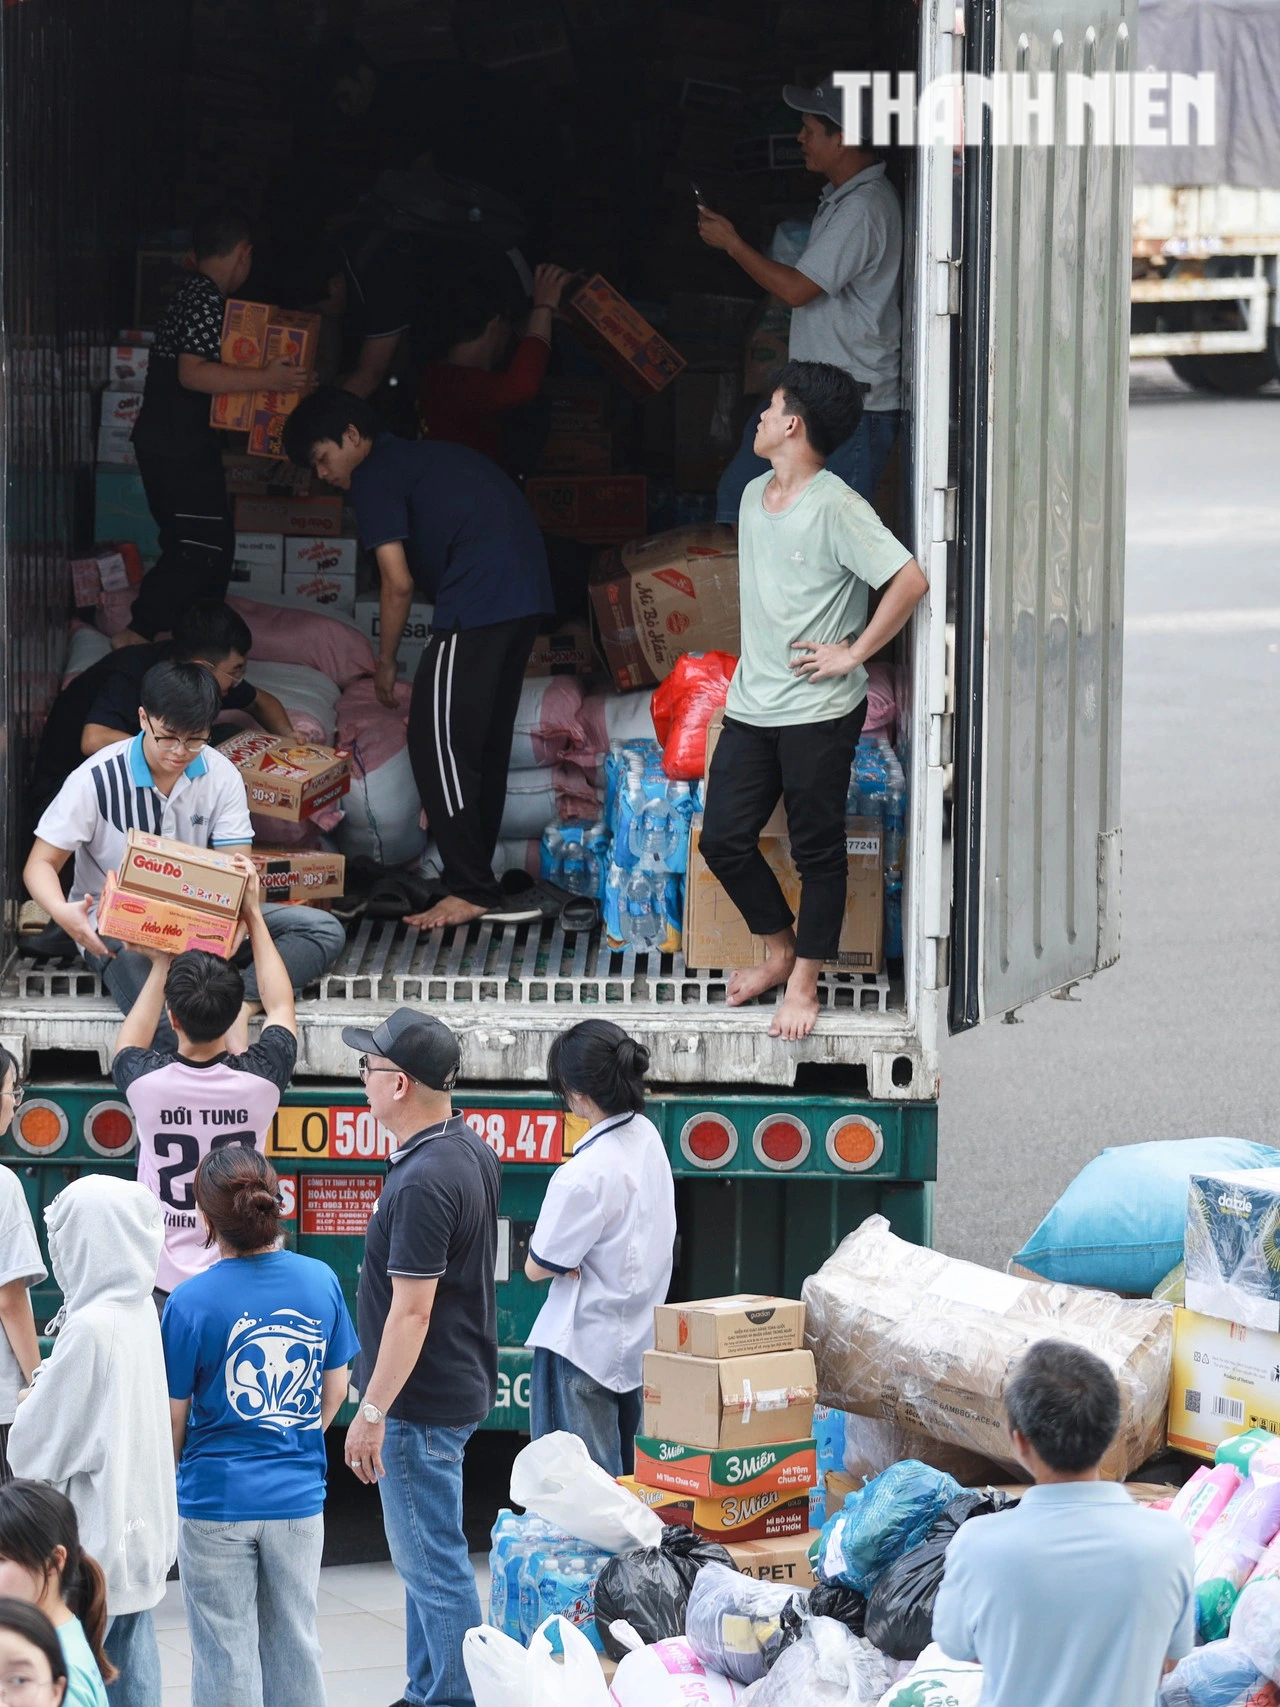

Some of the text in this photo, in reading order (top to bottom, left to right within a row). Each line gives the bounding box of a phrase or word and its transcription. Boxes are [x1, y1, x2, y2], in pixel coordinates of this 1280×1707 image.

[251, 787, 276, 805] 30+3
[847, 840, 877, 850] 77241
[133, 854, 183, 879] Gấu Đỏ
[303, 873, 324, 886] 30+3
[199, 1109, 249, 1125] TUNG
[308, 1187, 376, 1199] HOÀNG LIÊN SƠN
[1218, 1192, 1253, 1212] dazzle
[782, 1465, 809, 1475] Mì Tôm
[674, 1476, 688, 1486] Chua
[688, 1480, 699, 1489] Cay
[777, 1473, 811, 1485] Chua Cay
[787, 1499, 802, 1507] GOLD
[766, 1516, 775, 1526] MÌ
[775, 1515, 785, 1525] BÒ
[765, 1522, 802, 1534] RAU THƠM
[758, 1562, 797, 1581] PET
